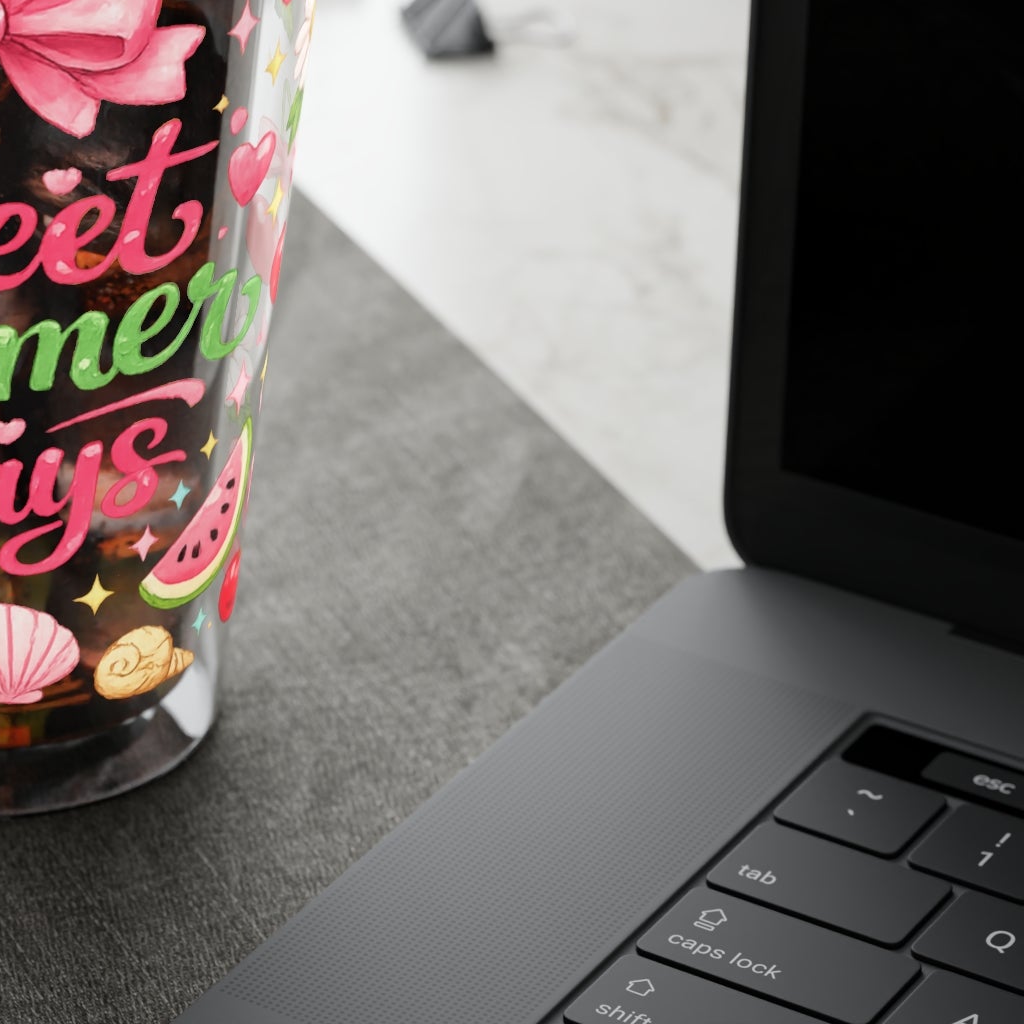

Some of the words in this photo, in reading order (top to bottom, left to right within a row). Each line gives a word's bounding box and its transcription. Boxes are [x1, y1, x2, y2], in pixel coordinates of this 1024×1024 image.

[972, 774, 1016, 795] esc
[977, 850, 994, 867] 1
[737, 863, 778, 886] tab
[985, 929, 1017, 954] Q
[667, 933, 726, 960] caps
[729, 951, 782, 980] lock
